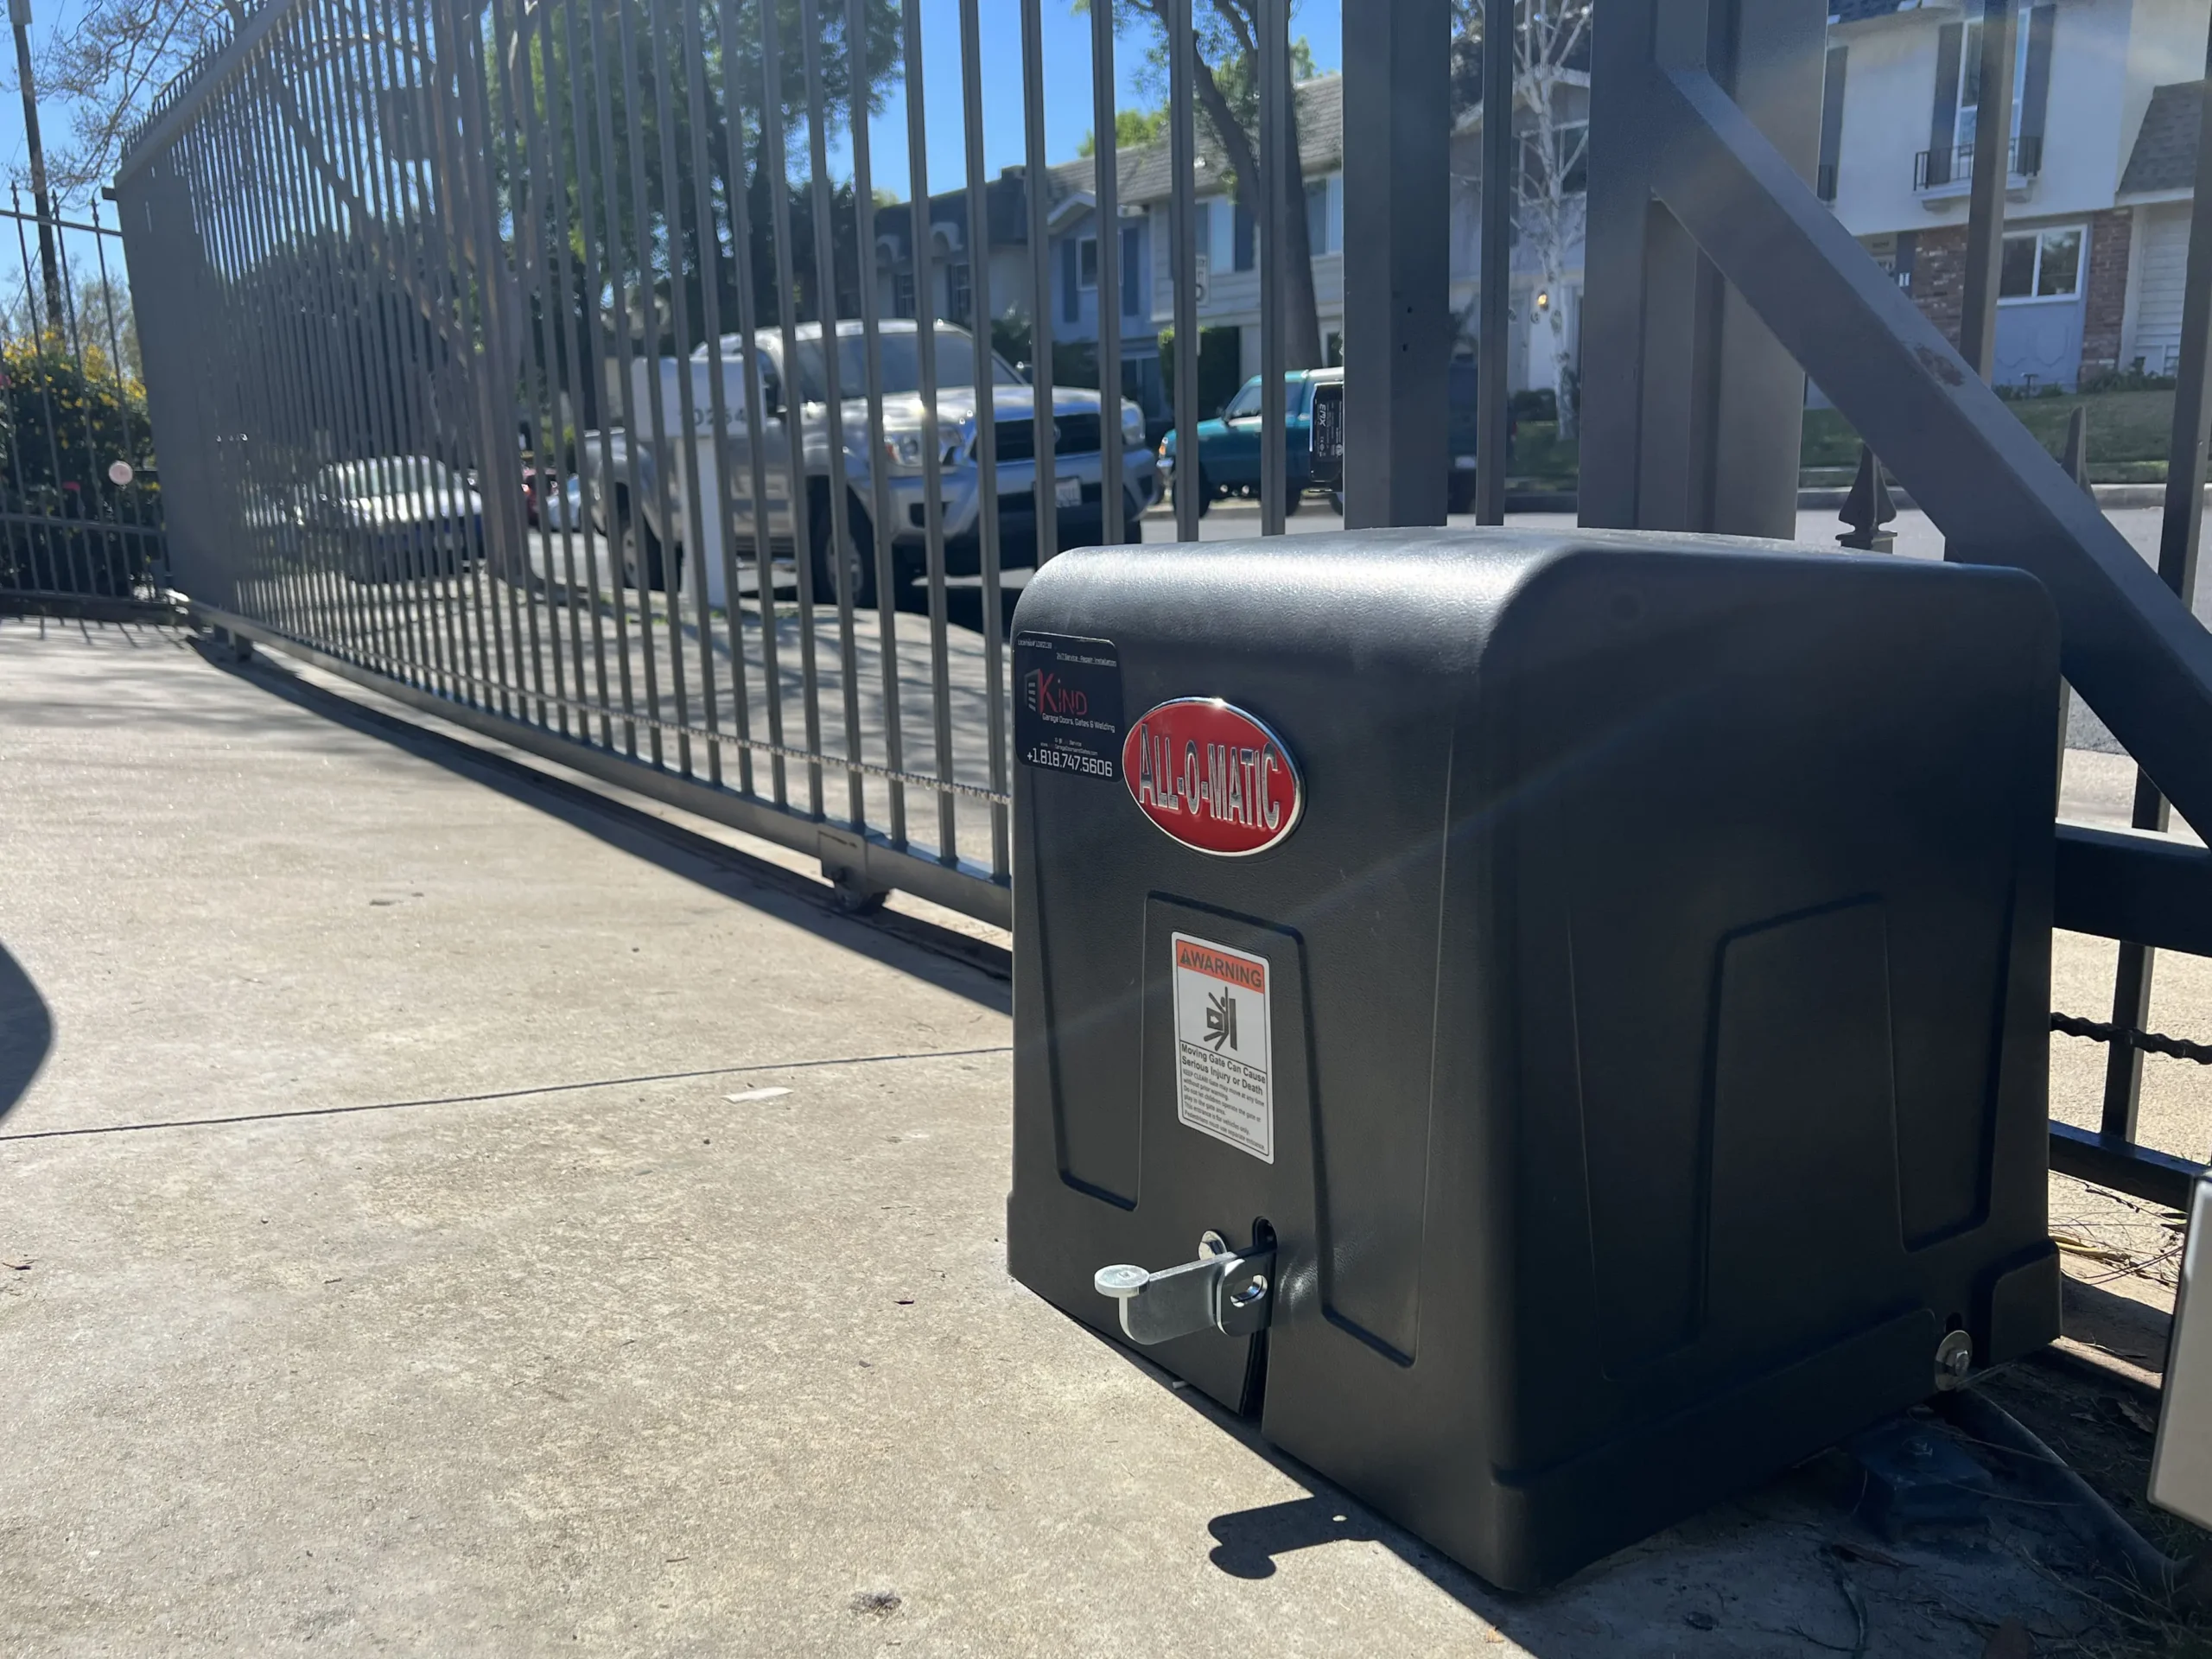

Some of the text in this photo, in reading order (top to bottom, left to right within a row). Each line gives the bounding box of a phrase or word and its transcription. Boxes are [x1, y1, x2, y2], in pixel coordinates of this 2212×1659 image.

[1042, 713, 1059, 723] Garage
[1058, 715, 1075, 726] Doors,
[1074, 718, 1089, 728] Gates
[1094, 721, 1116, 734] Welding
[1027, 747, 1113, 778] +1.818.747.5606
[1139, 723, 1281, 831] ALL-O-MATIC
[1192, 950, 1262, 988] WARNING
[1181, 1043, 1265, 1084] Moving Gate Can Cause
[1182, 1055, 1262, 1096] Serious Injury or Death
